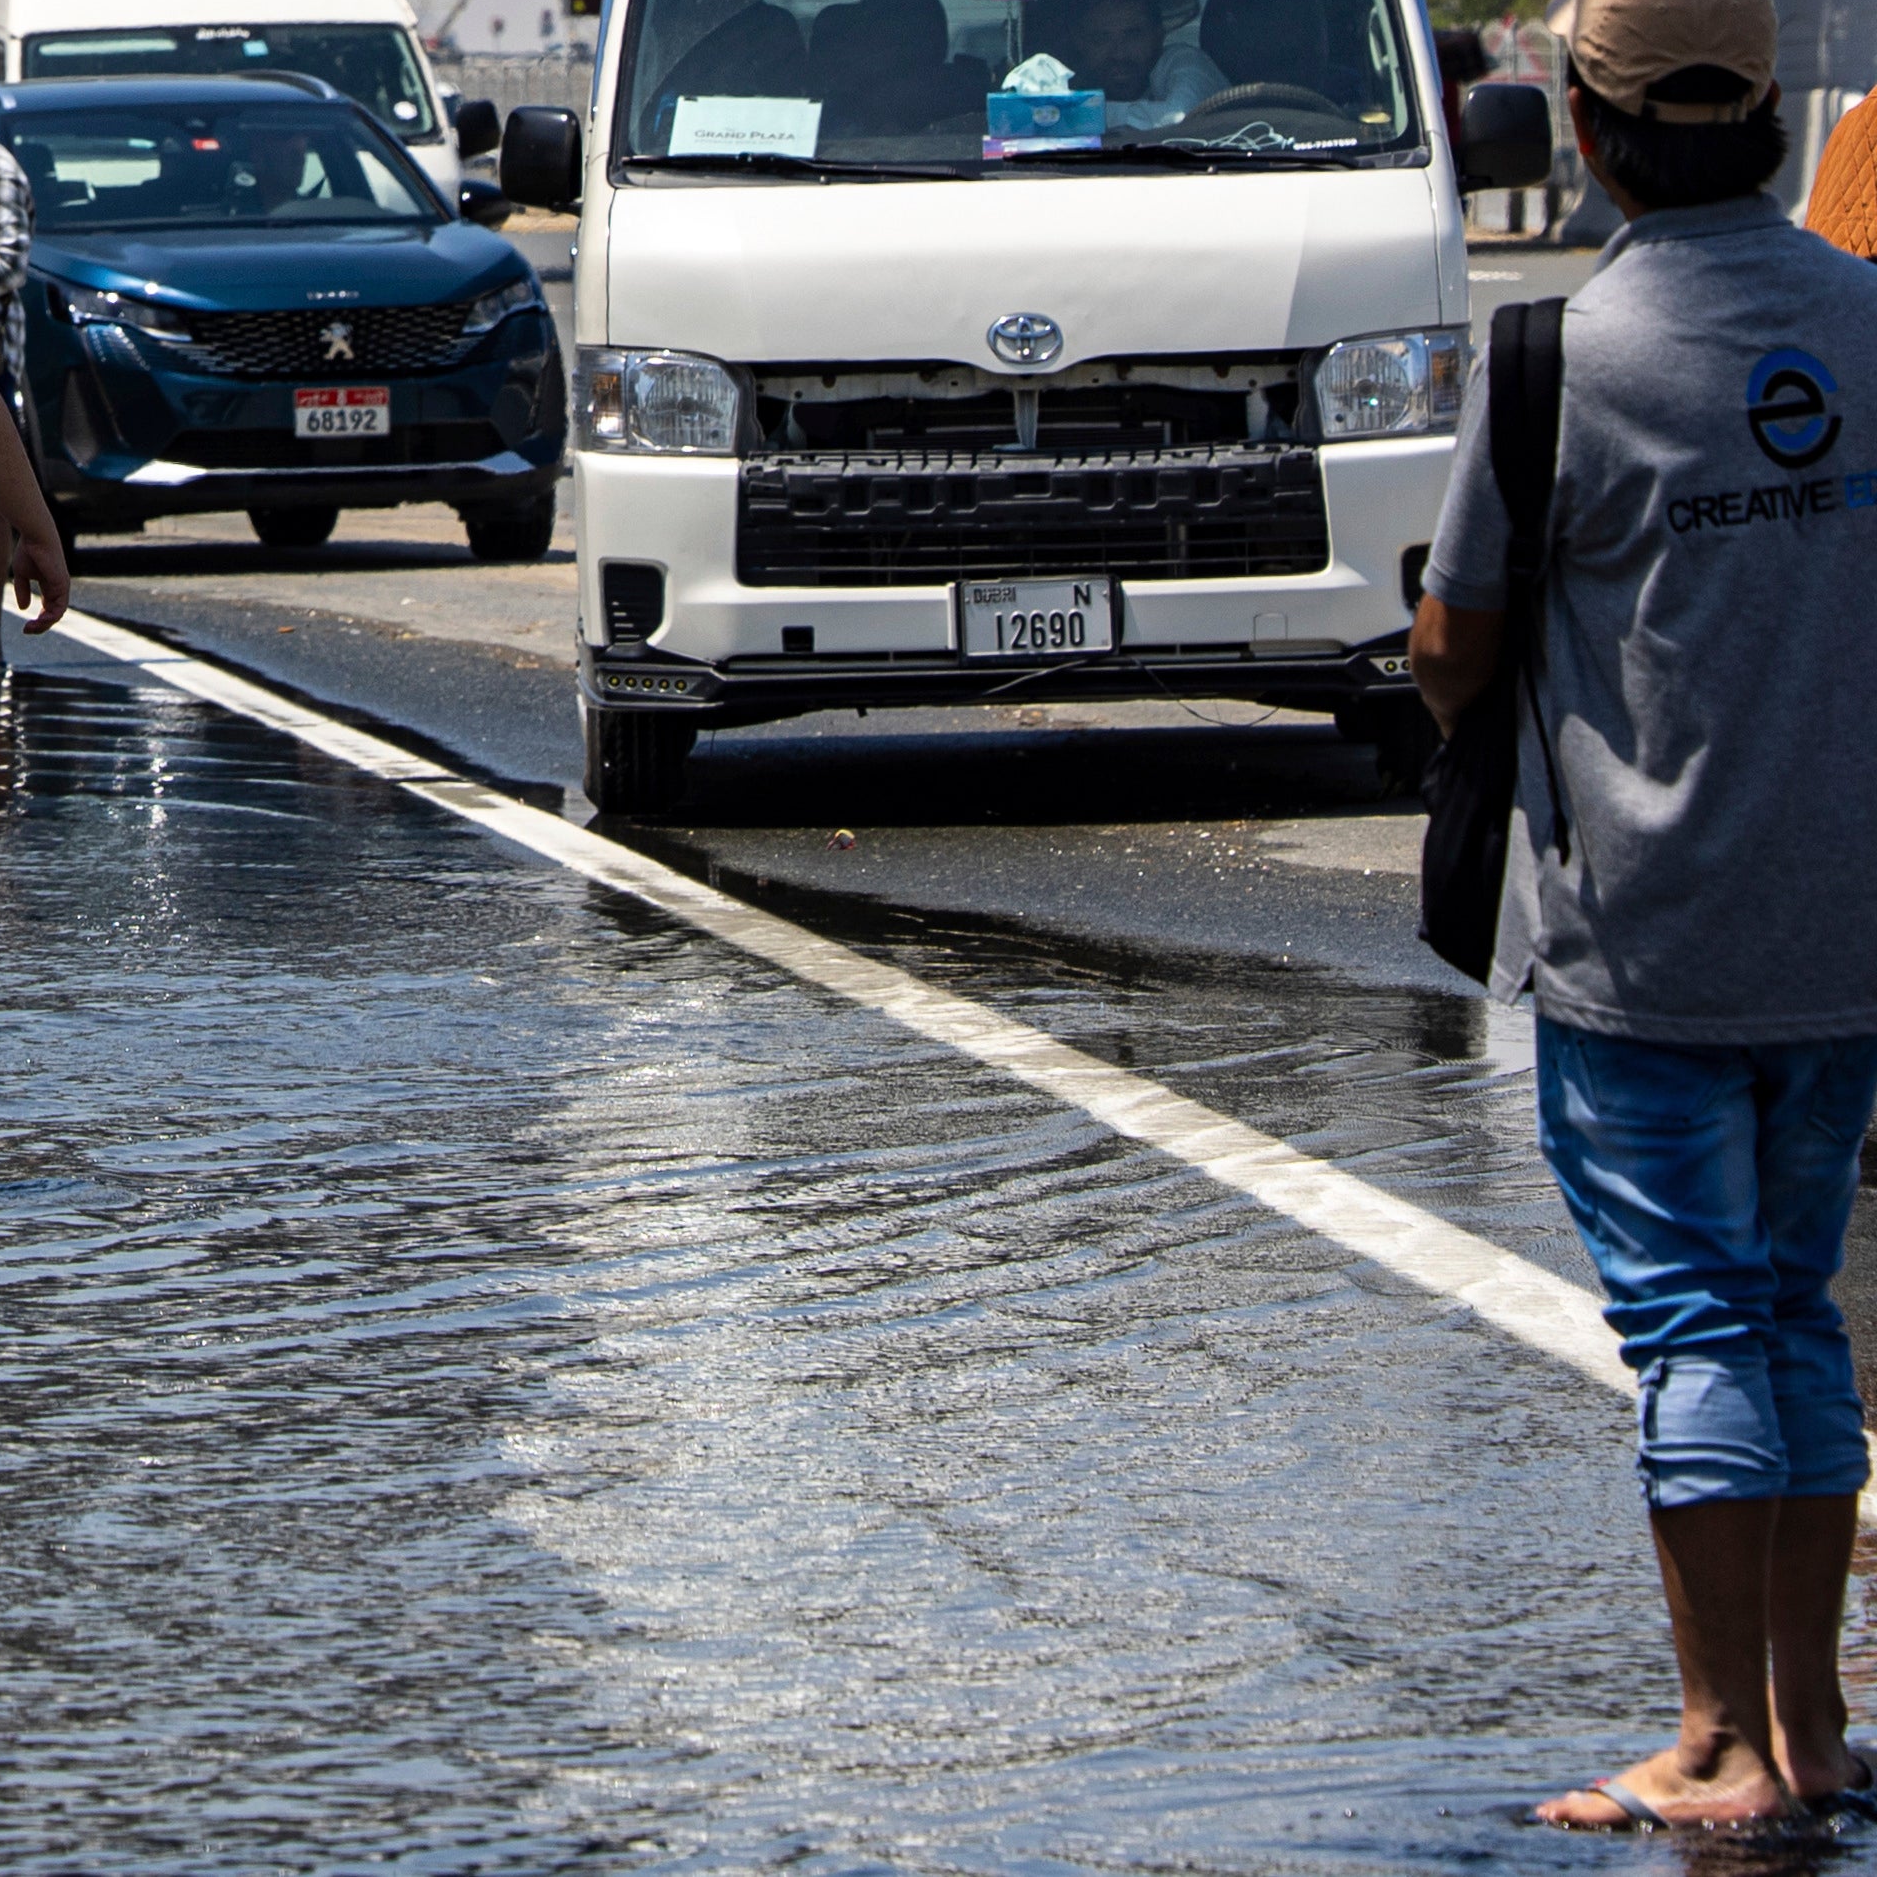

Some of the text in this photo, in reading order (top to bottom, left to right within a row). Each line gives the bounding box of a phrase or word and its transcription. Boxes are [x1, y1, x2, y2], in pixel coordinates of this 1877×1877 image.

[695, 130, 796, 141] GRAND PLAZA
[307, 408, 377, 432] 68192
[1667, 479, 1836, 534] CREATIVE
[1074, 583, 1091, 606] N
[995, 609, 1085, 651] 12690
